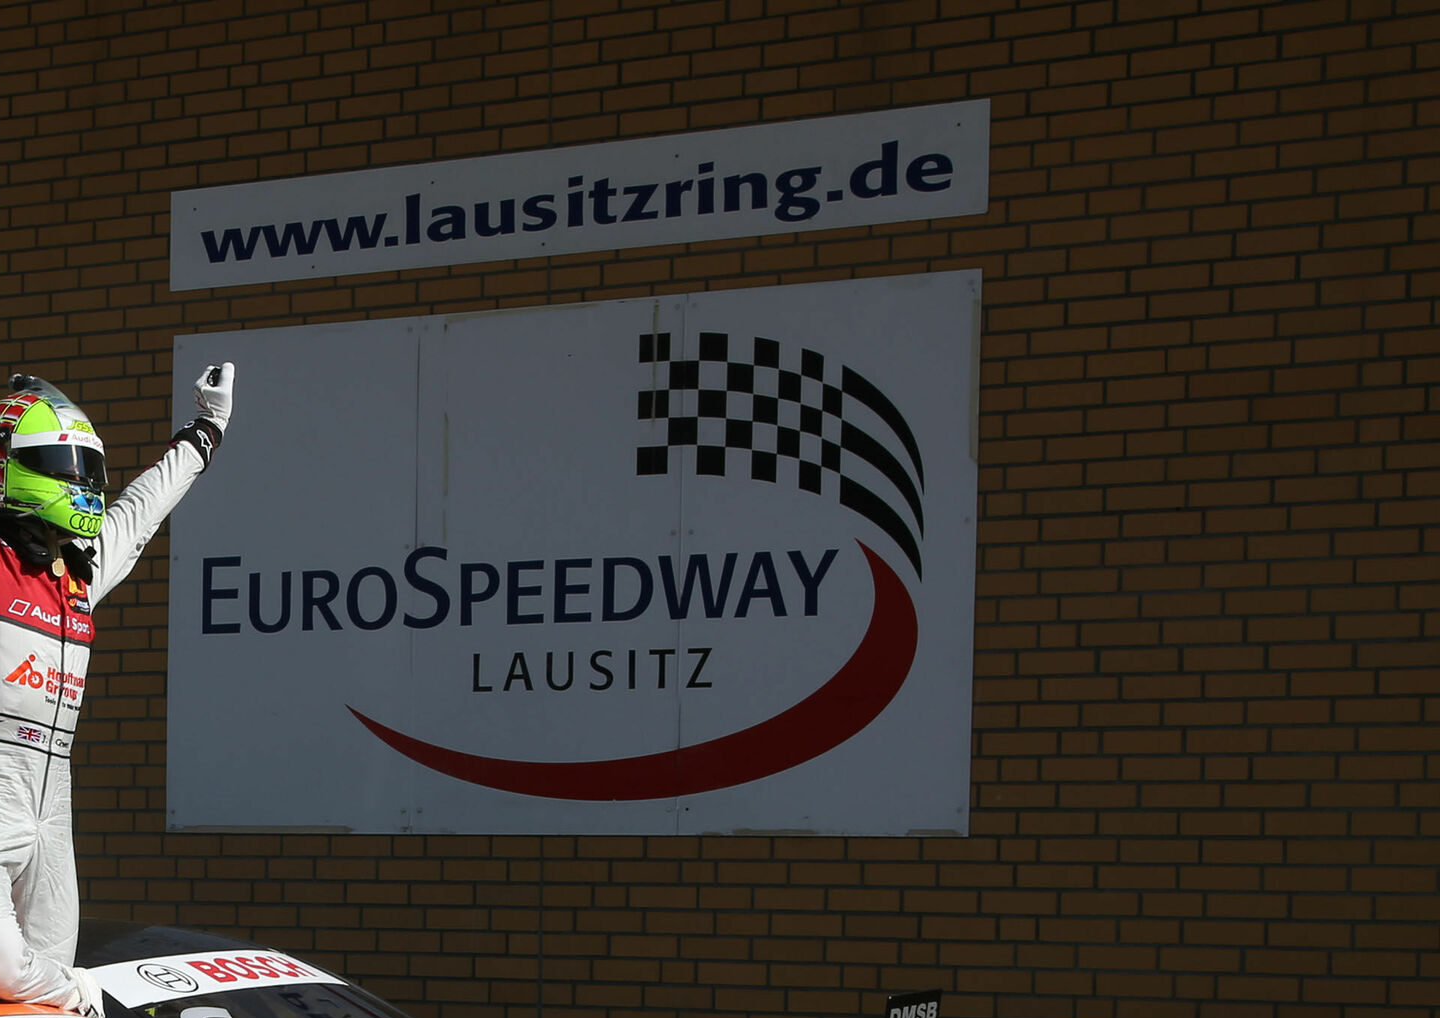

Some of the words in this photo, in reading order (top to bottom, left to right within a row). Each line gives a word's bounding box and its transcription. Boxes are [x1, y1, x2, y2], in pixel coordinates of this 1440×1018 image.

[200, 140, 954, 263] www.lausitzring.de
[31, 605, 70, 629] Audi
[473, 647, 713, 693] LAUSITZ
[186, 955, 320, 984] BOSCH
